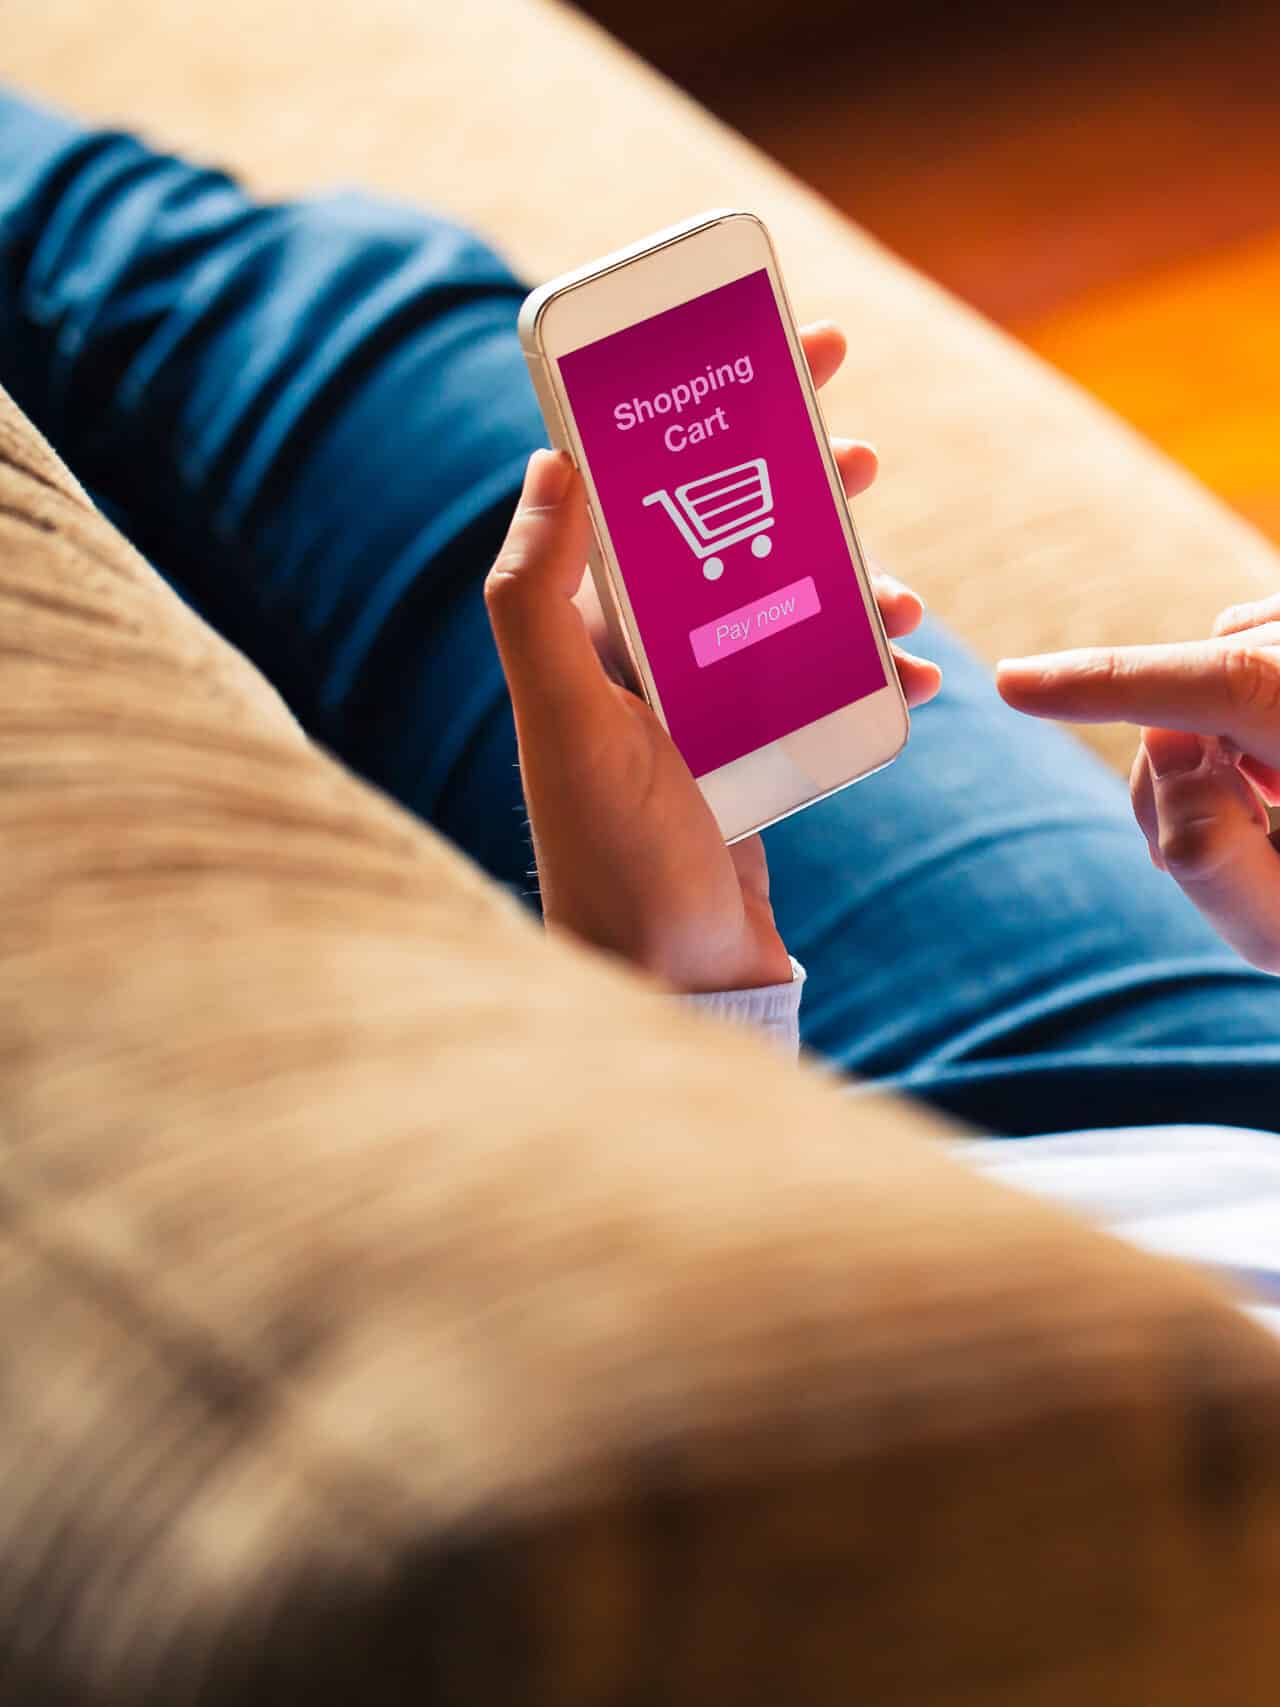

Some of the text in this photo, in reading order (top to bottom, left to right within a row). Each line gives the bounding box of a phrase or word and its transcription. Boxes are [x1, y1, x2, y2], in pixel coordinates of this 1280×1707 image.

[613, 355, 754, 431] Shopping
[664, 407, 730, 452] Cart
[716, 596, 796, 647] Pay now
